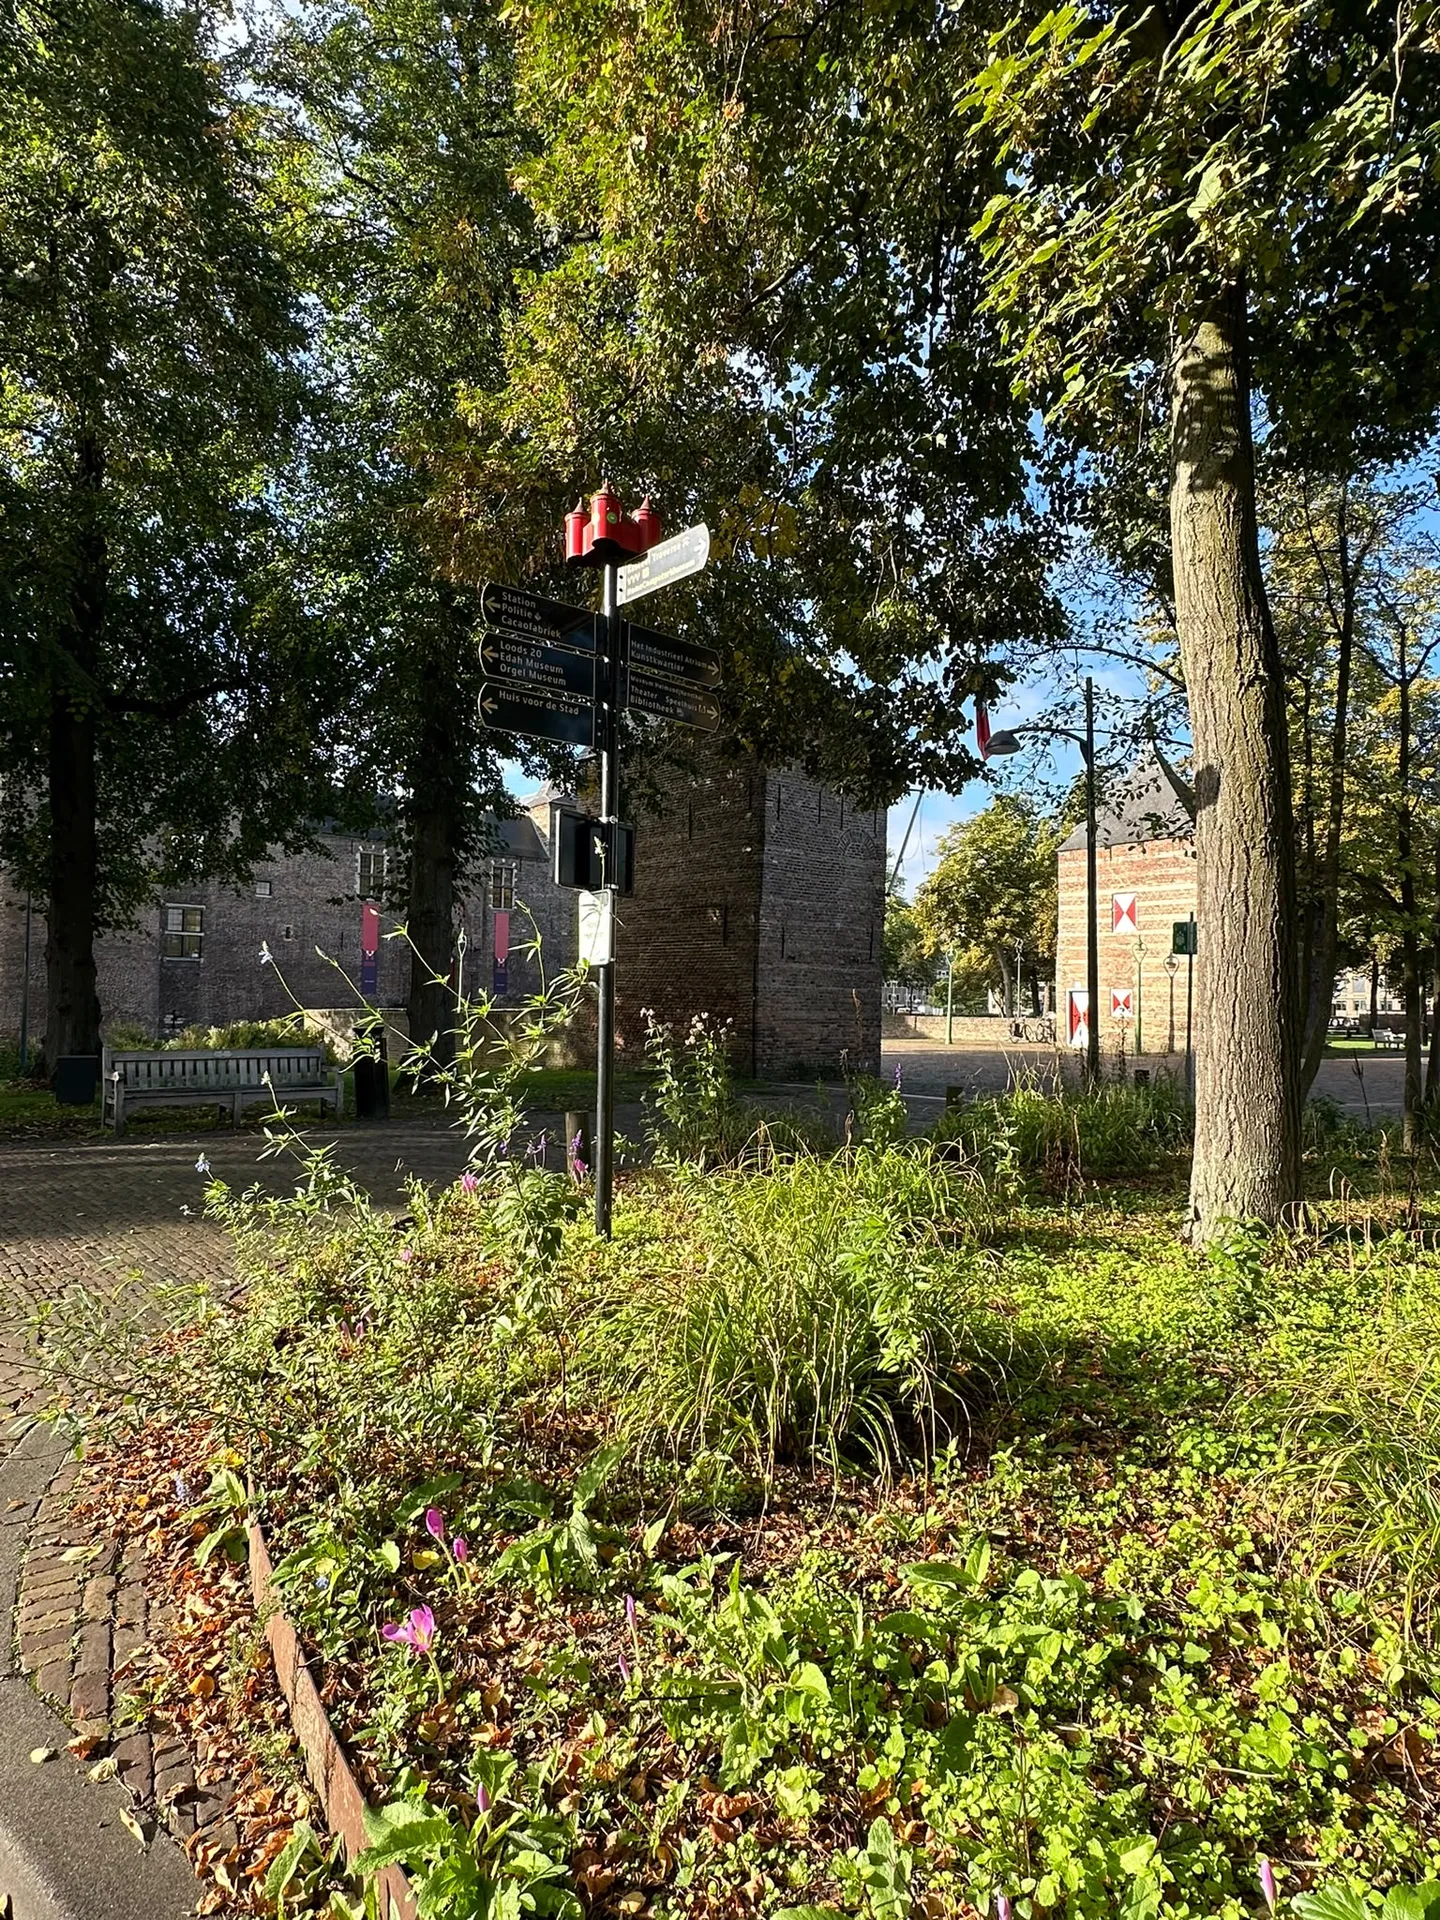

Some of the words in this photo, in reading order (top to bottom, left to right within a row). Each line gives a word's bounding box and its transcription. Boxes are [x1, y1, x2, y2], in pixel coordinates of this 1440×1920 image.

[502, 591, 536, 609] Station
[502, 602, 533, 618] Politie
[501, 615, 562, 639] Cacaofabriek
[500, 641, 528, 655] Loods
[530, 648, 542, 658] 20
[631, 640, 644, 651] Het
[645, 644, 684, 662] Industrieel
[500, 652, 523, 665] Edah
[525, 658, 564, 675] Museum
[631, 650, 685, 672] Kunstkwartier
[500, 663, 526, 677] Orgel
[528, 670, 567, 686] Museum
[499, 690, 520, 703] Huis
[522, 697, 543, 707] voor
[546, 701, 557, 711] de
[559, 703, 580, 715] Stad
[631, 685, 658, 699] Theater
[630, 695, 675, 714] Bibliotheek
